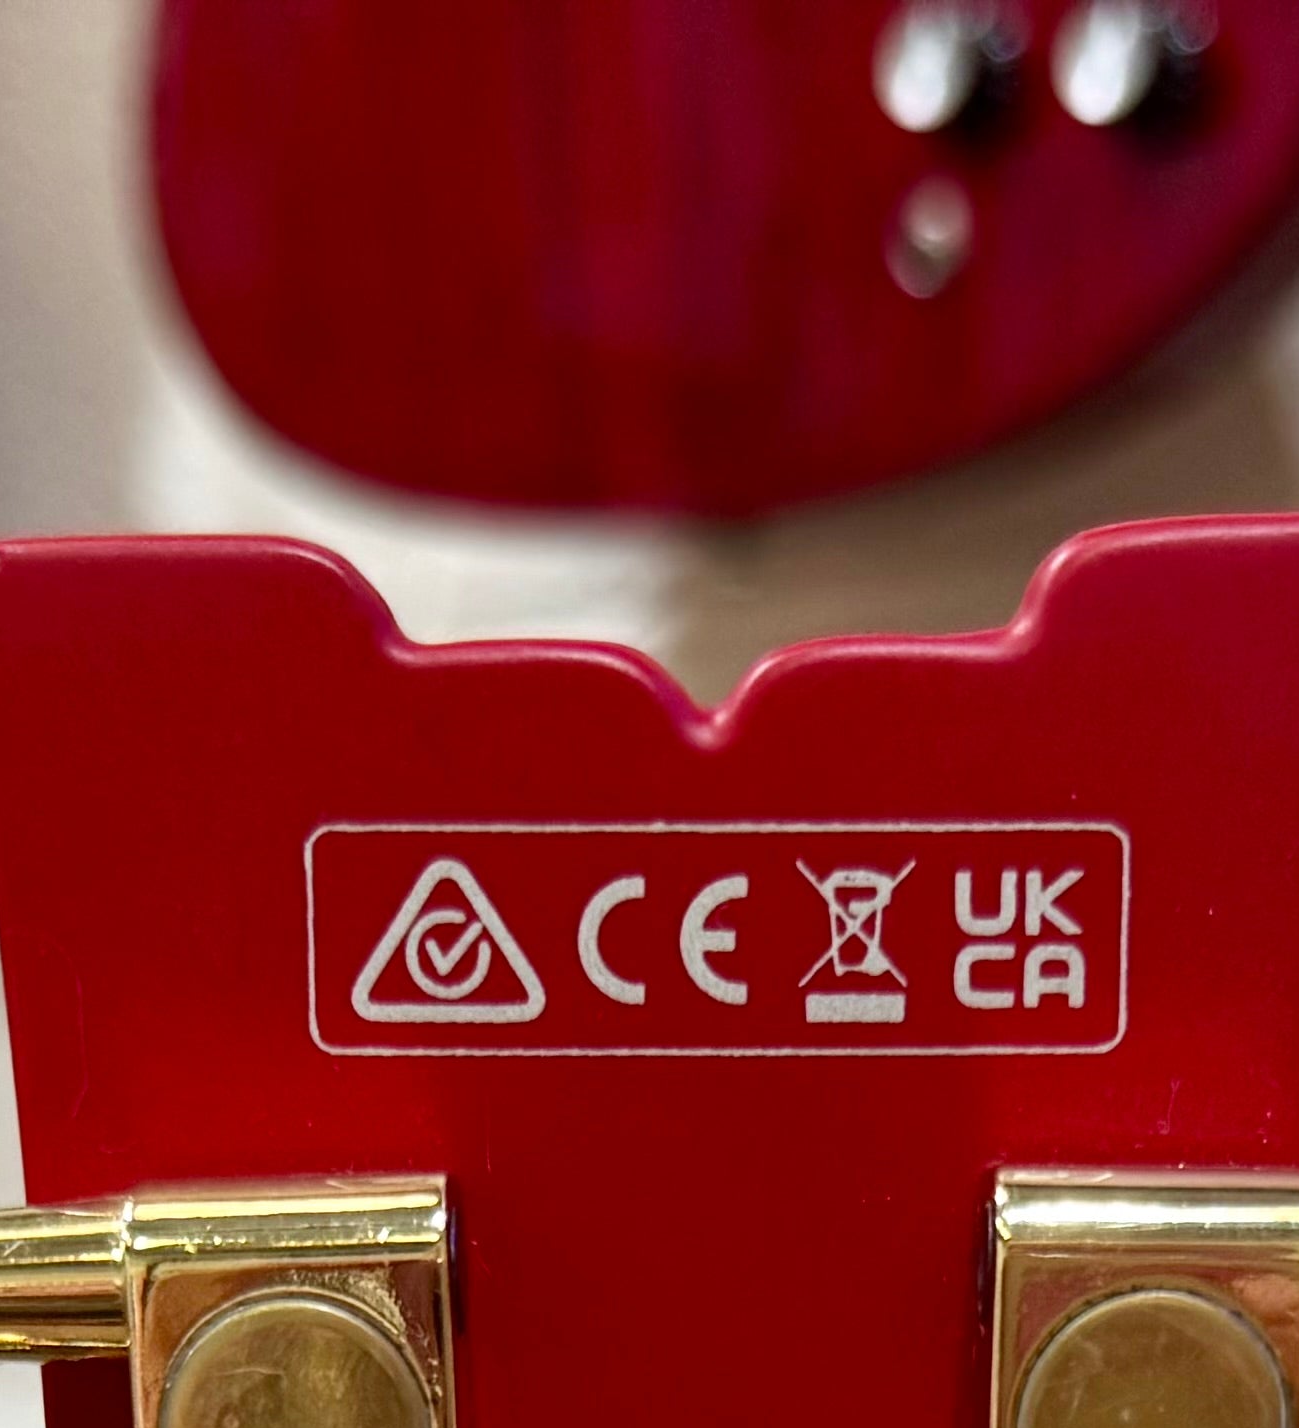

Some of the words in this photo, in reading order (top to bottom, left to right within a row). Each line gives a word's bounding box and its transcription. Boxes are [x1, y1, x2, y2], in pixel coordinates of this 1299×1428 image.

[954, 870, 1084, 936] UK
[577, 875, 749, 1005] CE
[953, 944, 1085, 1009] CA
